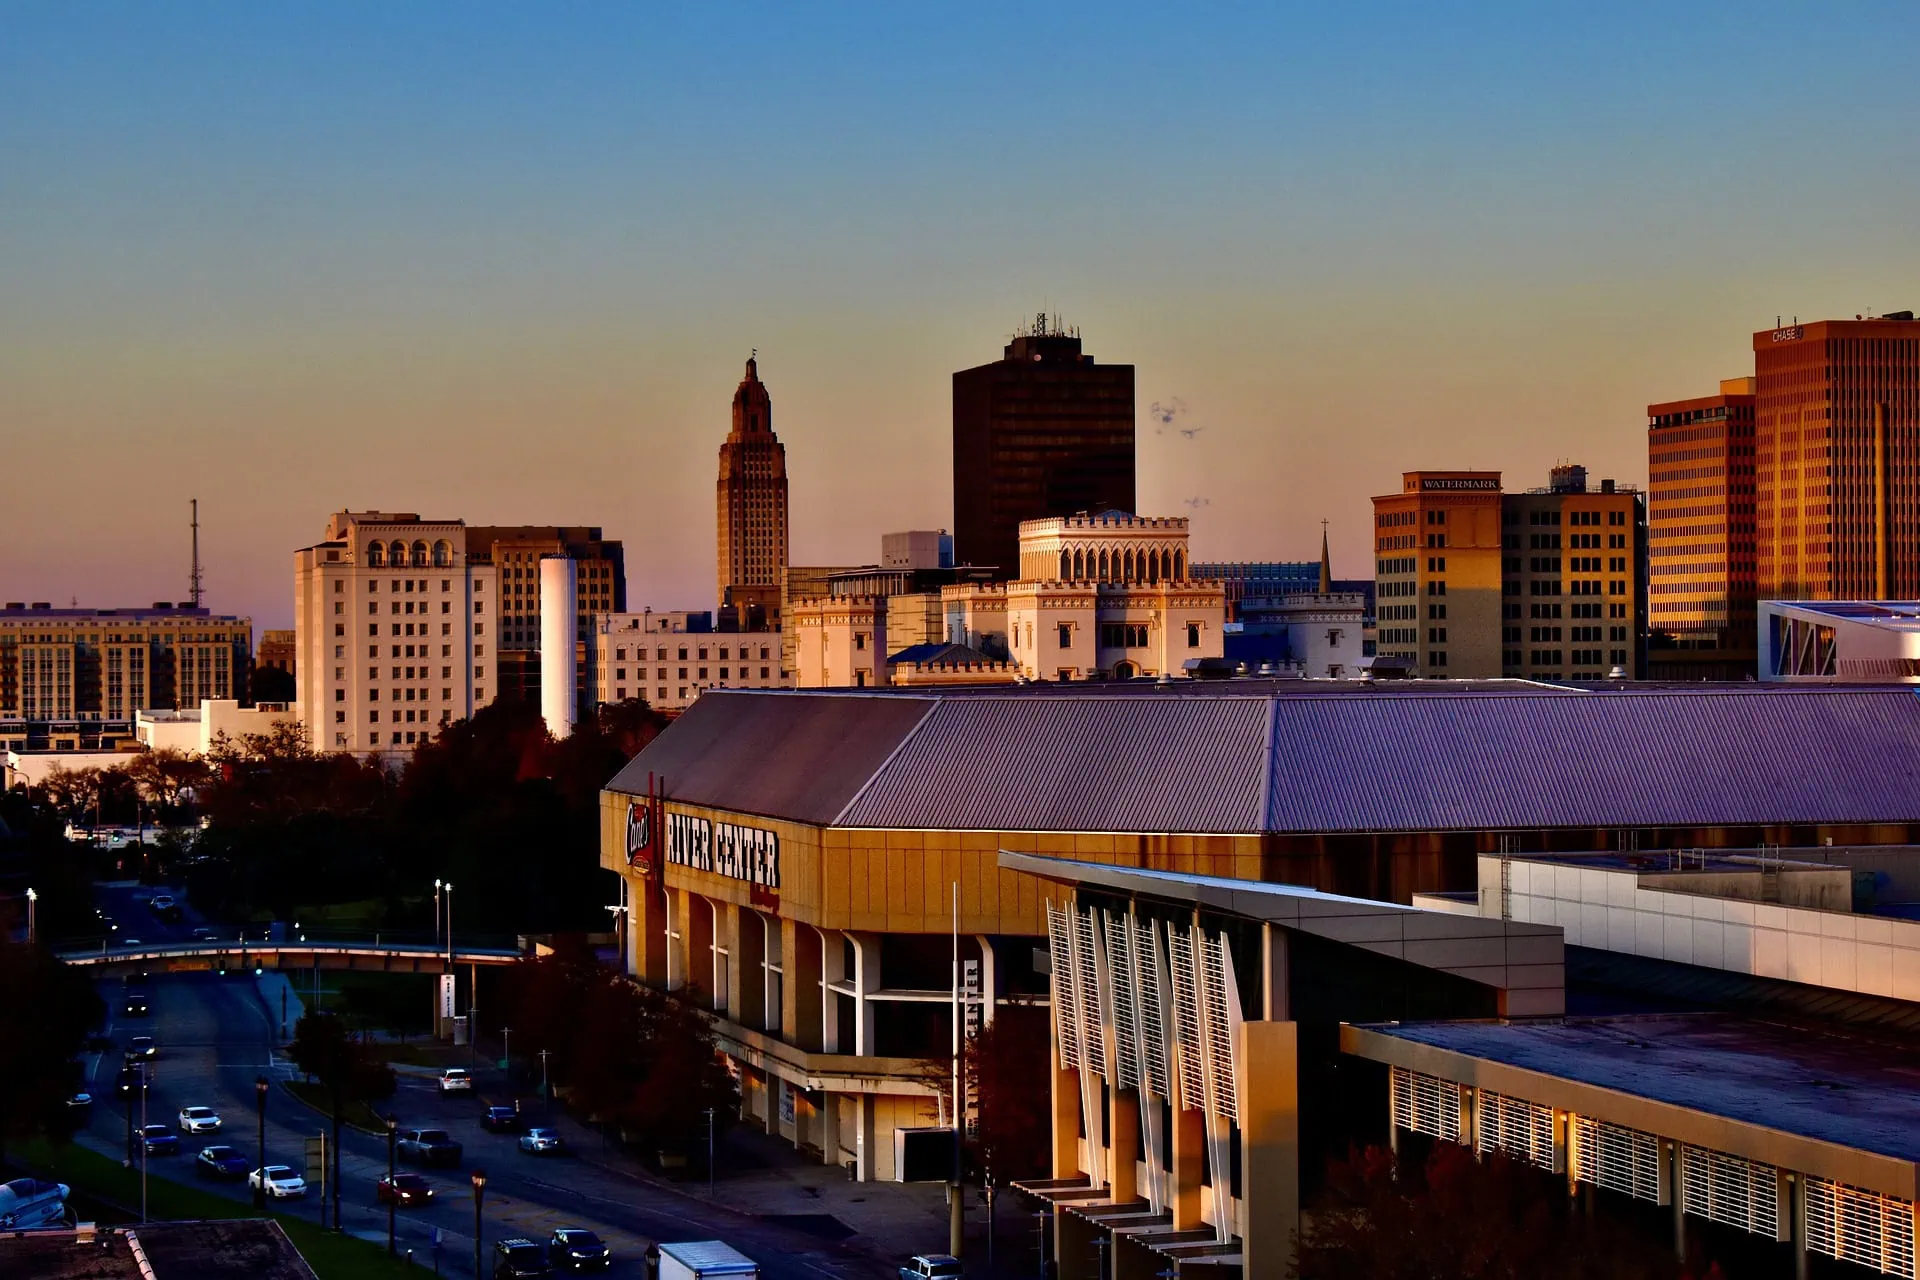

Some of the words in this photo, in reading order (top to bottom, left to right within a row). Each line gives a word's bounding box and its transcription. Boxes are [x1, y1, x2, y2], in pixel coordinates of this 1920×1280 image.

[1772, 328, 1796, 343] CHASE
[1423, 480, 1497, 489] WATERMARK
[666, 813, 711, 872] RIVER
[715, 822, 778, 888] CENTER
[967, 967, 979, 1040] CENTER
